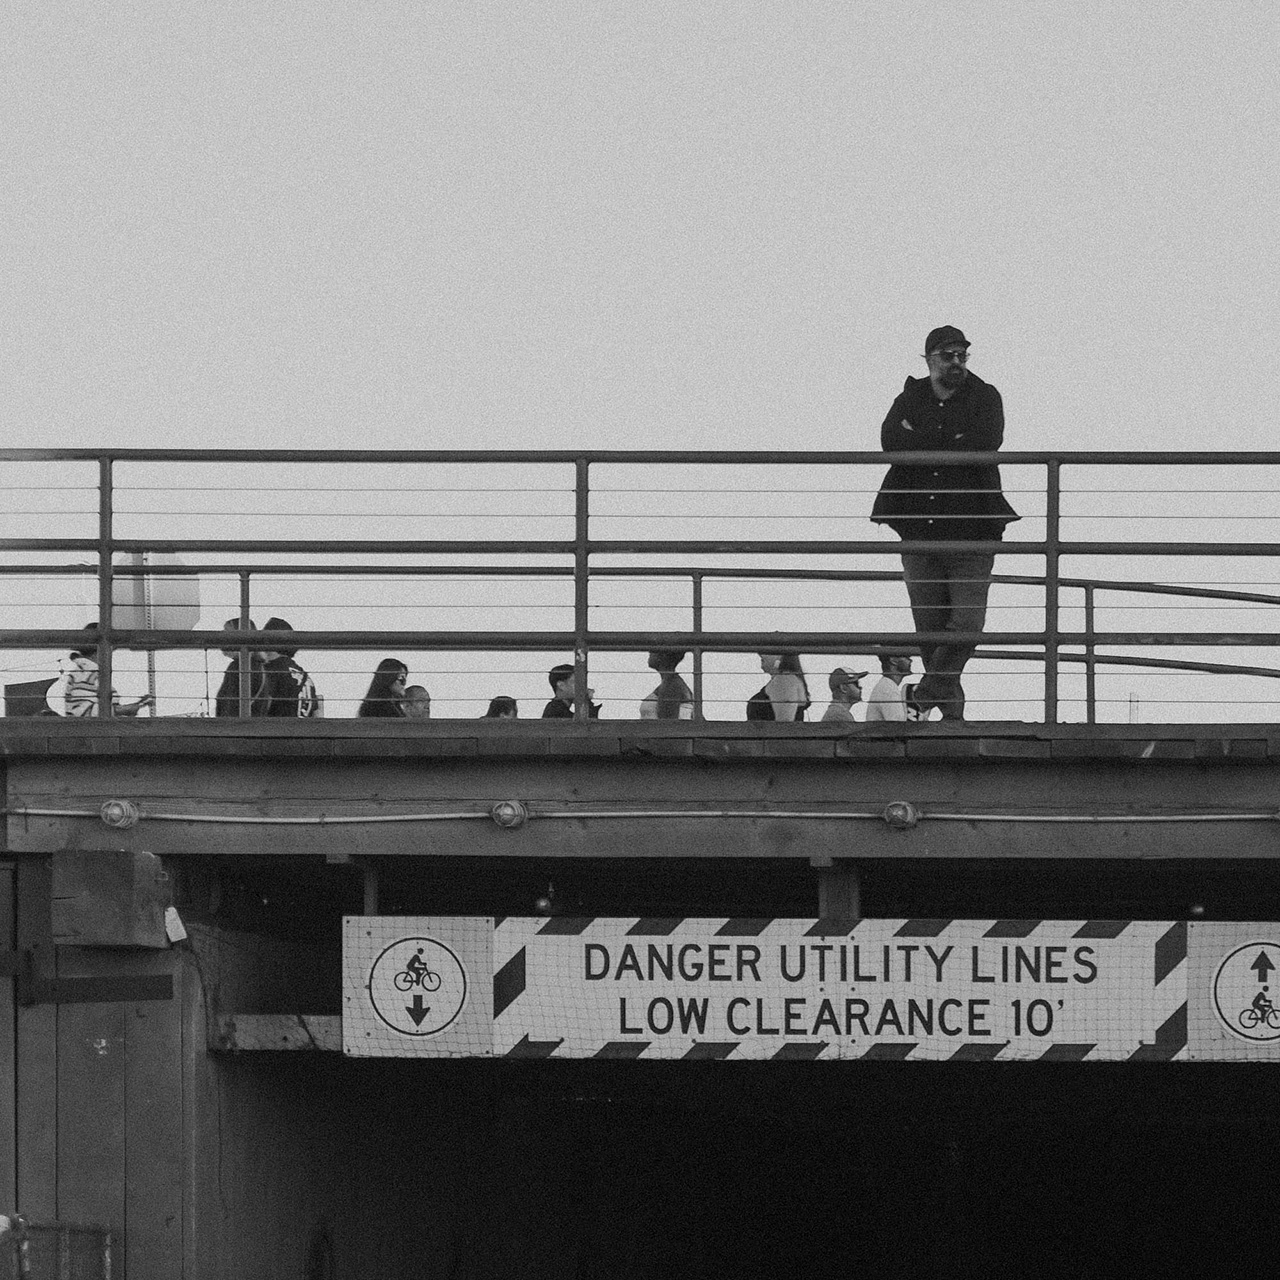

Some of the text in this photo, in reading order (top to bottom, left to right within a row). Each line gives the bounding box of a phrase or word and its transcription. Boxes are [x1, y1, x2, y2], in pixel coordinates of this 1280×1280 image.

[585, 943, 1098, 984] DANGER UTILITY LINES
[620, 997, 1064, 1037] LOW CLEARANCE 10'
